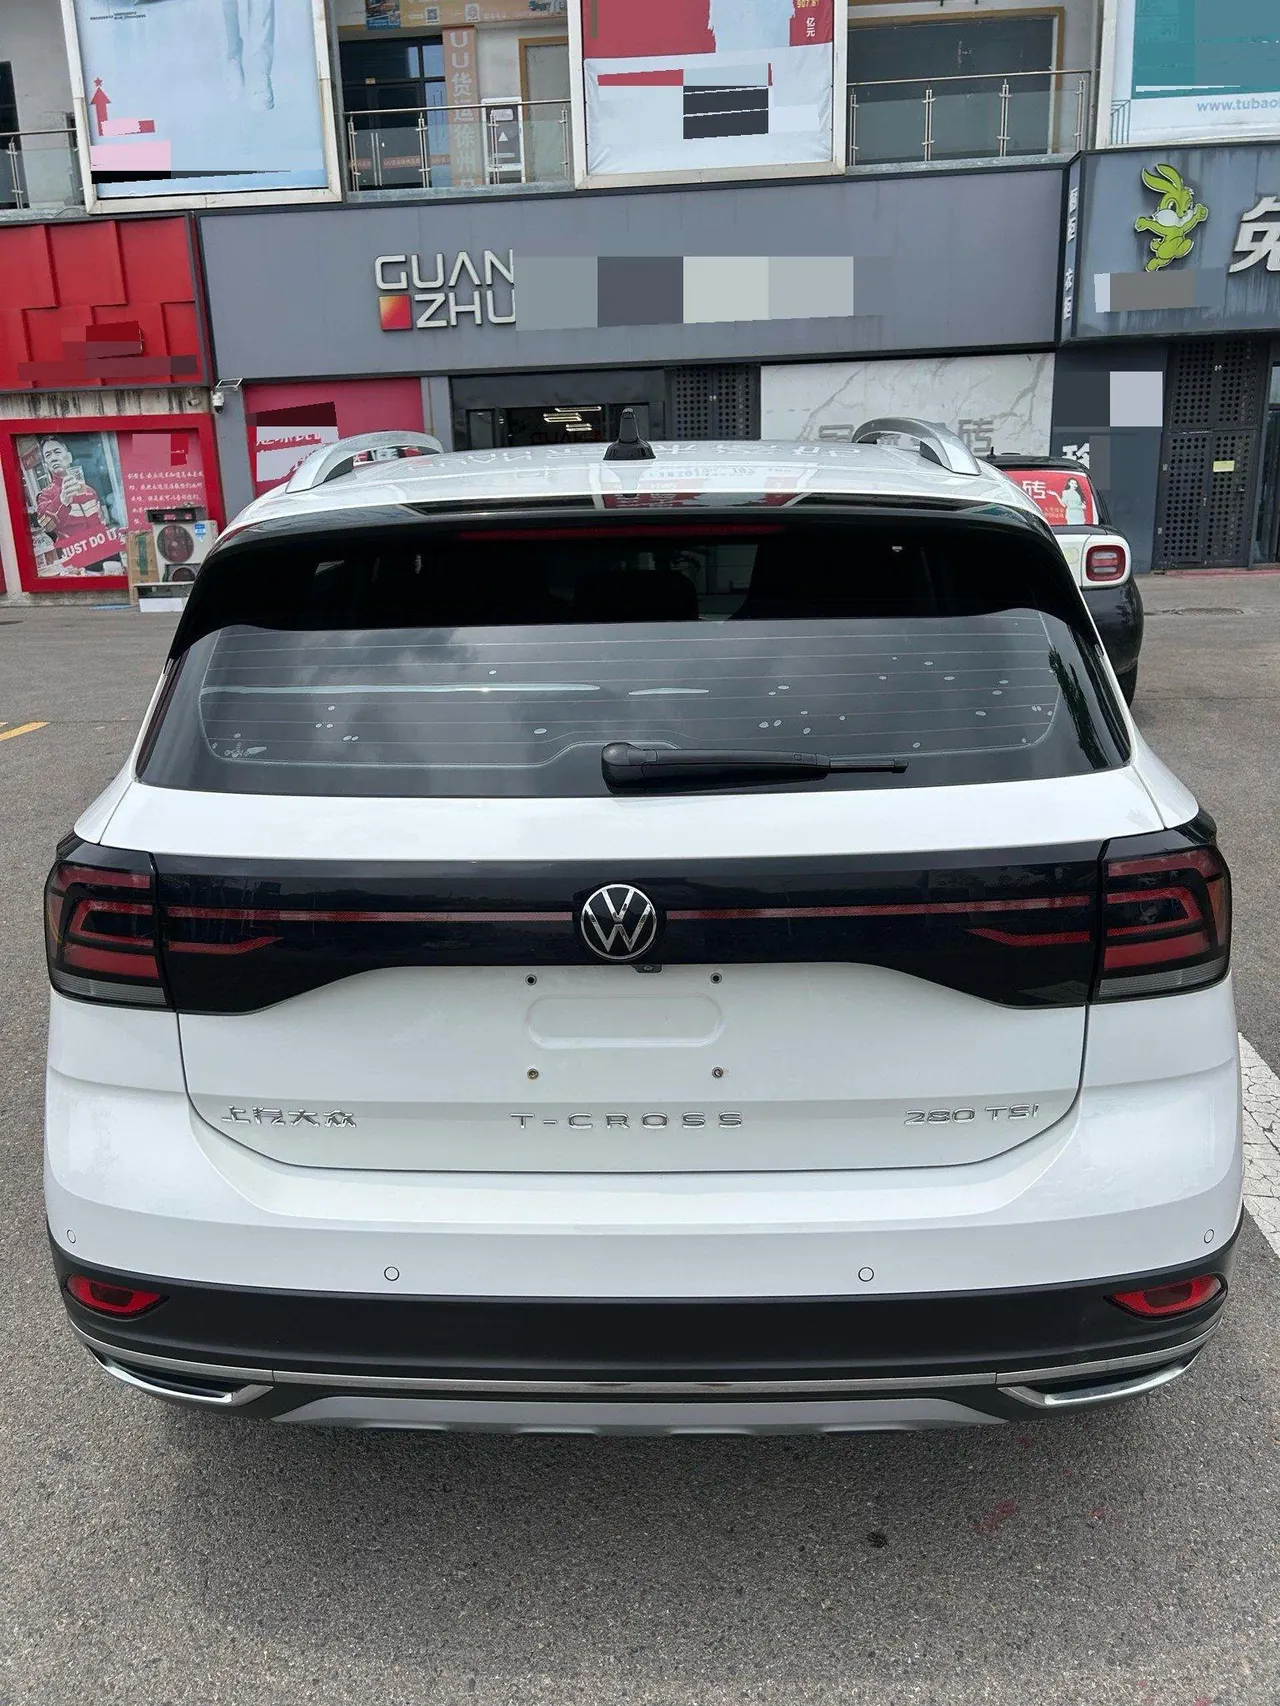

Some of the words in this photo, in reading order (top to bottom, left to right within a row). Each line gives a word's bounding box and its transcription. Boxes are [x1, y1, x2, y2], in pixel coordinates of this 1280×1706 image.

[806, 17, 816, 37] 亿元
[1197, 98, 1280, 112] www.tubao
[374, 249, 514, 290] GUAN
[413, 289, 516, 329] ZHU
[61, 540, 87, 560] JUST
[89, 533, 106, 548] DO
[221, 1105, 356, 1128] 上汽大众
[510, 1112, 743, 1129] T-CROSS
[904, 1108, 975, 1126] 280
[985, 1103, 1039, 1122] TSI
